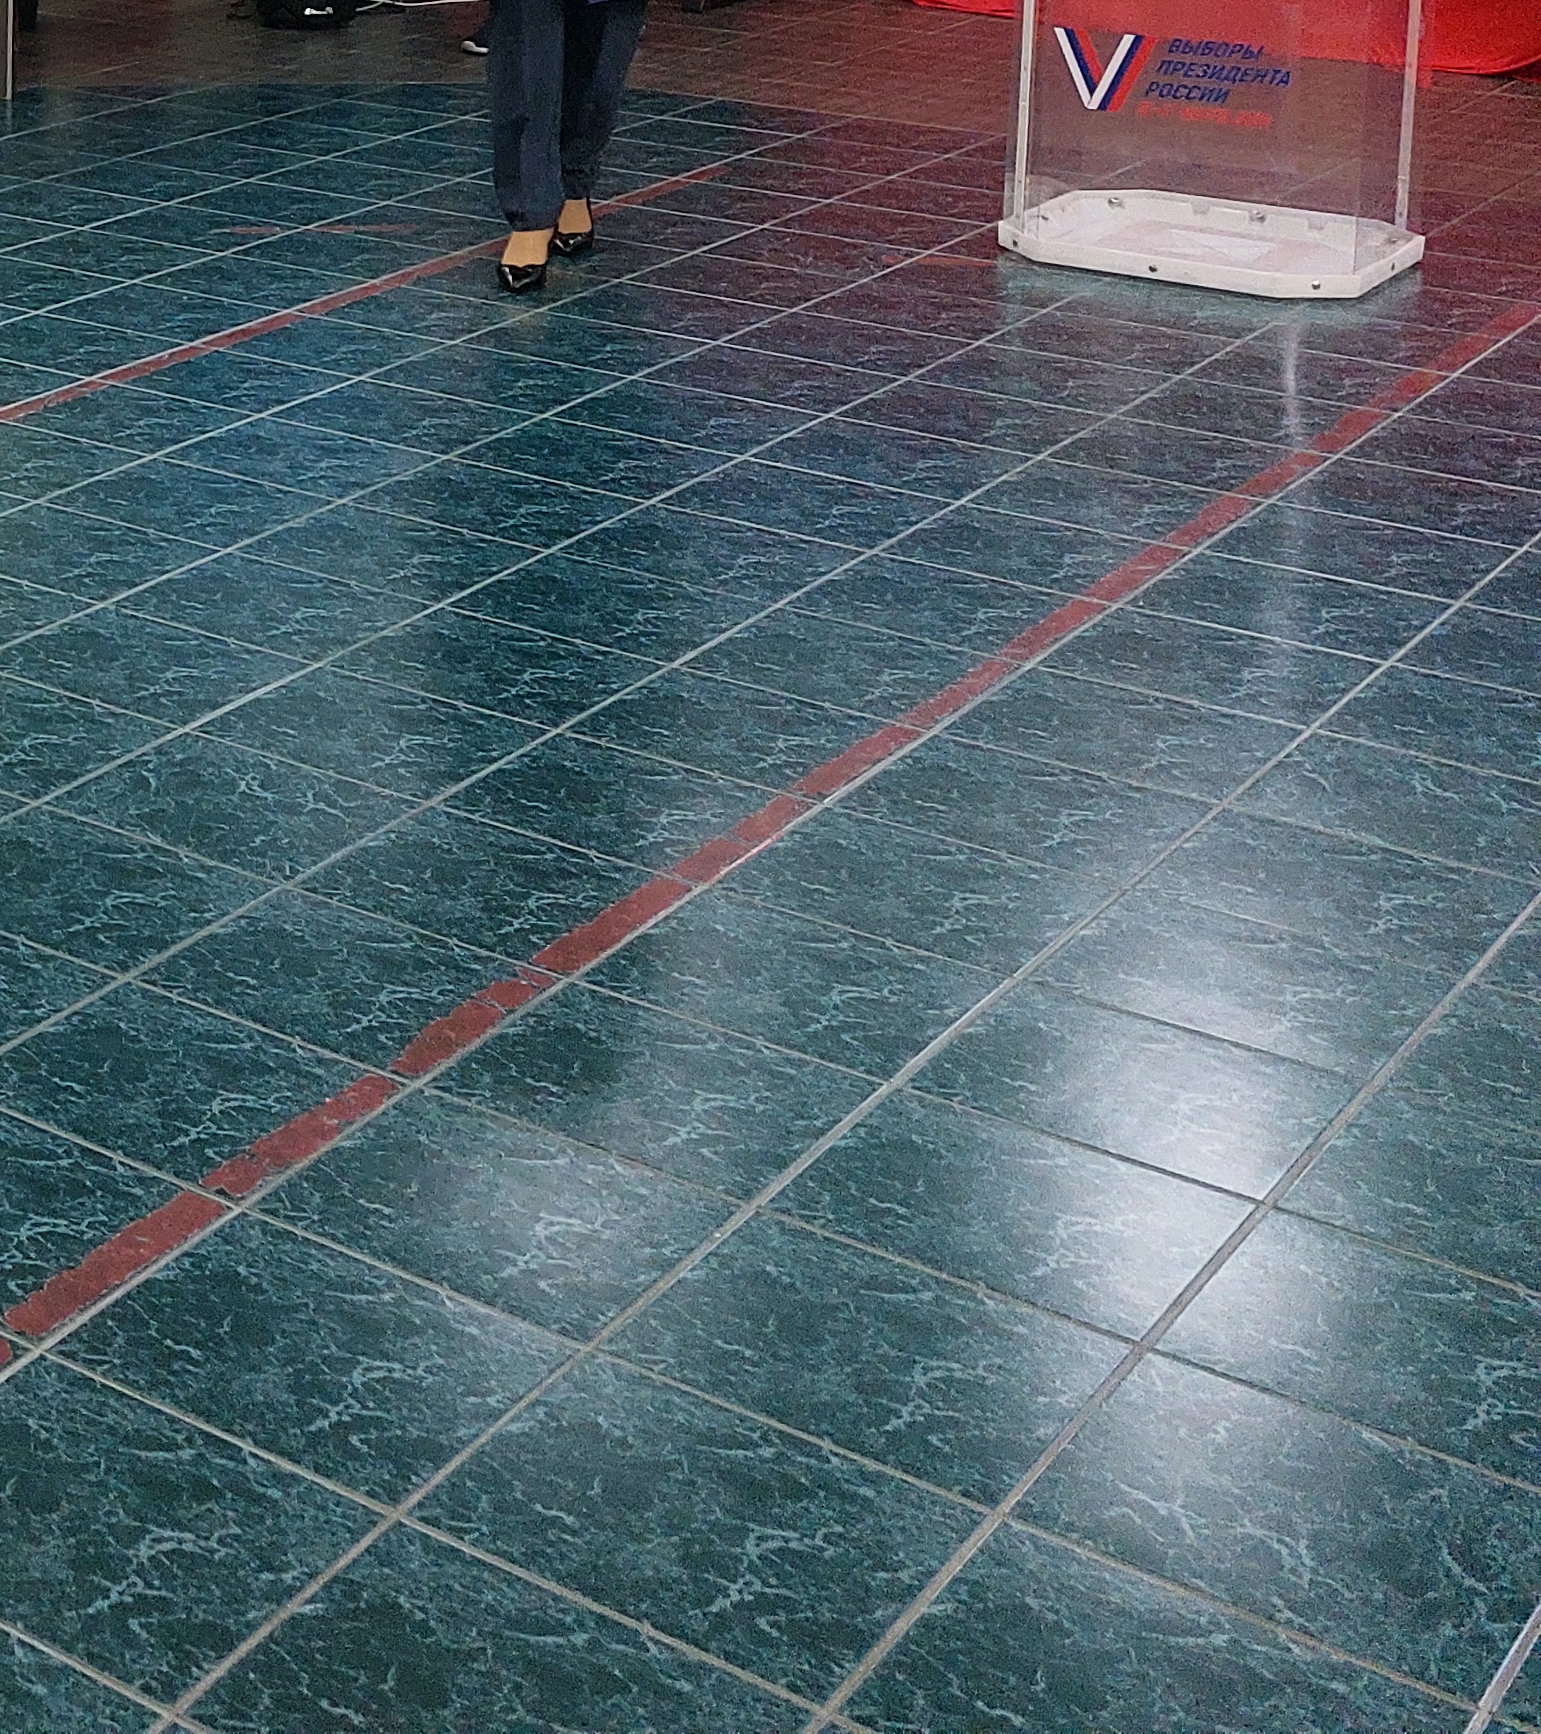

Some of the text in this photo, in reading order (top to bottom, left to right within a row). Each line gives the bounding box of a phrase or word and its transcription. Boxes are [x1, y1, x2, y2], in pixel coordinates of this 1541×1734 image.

[1168, 37, 1264, 61] ВЫБОРЫ
[1155, 59, 1292, 88] ПРЕЗИДЕНТА
[1143, 80, 1231, 104] РОССИИ
